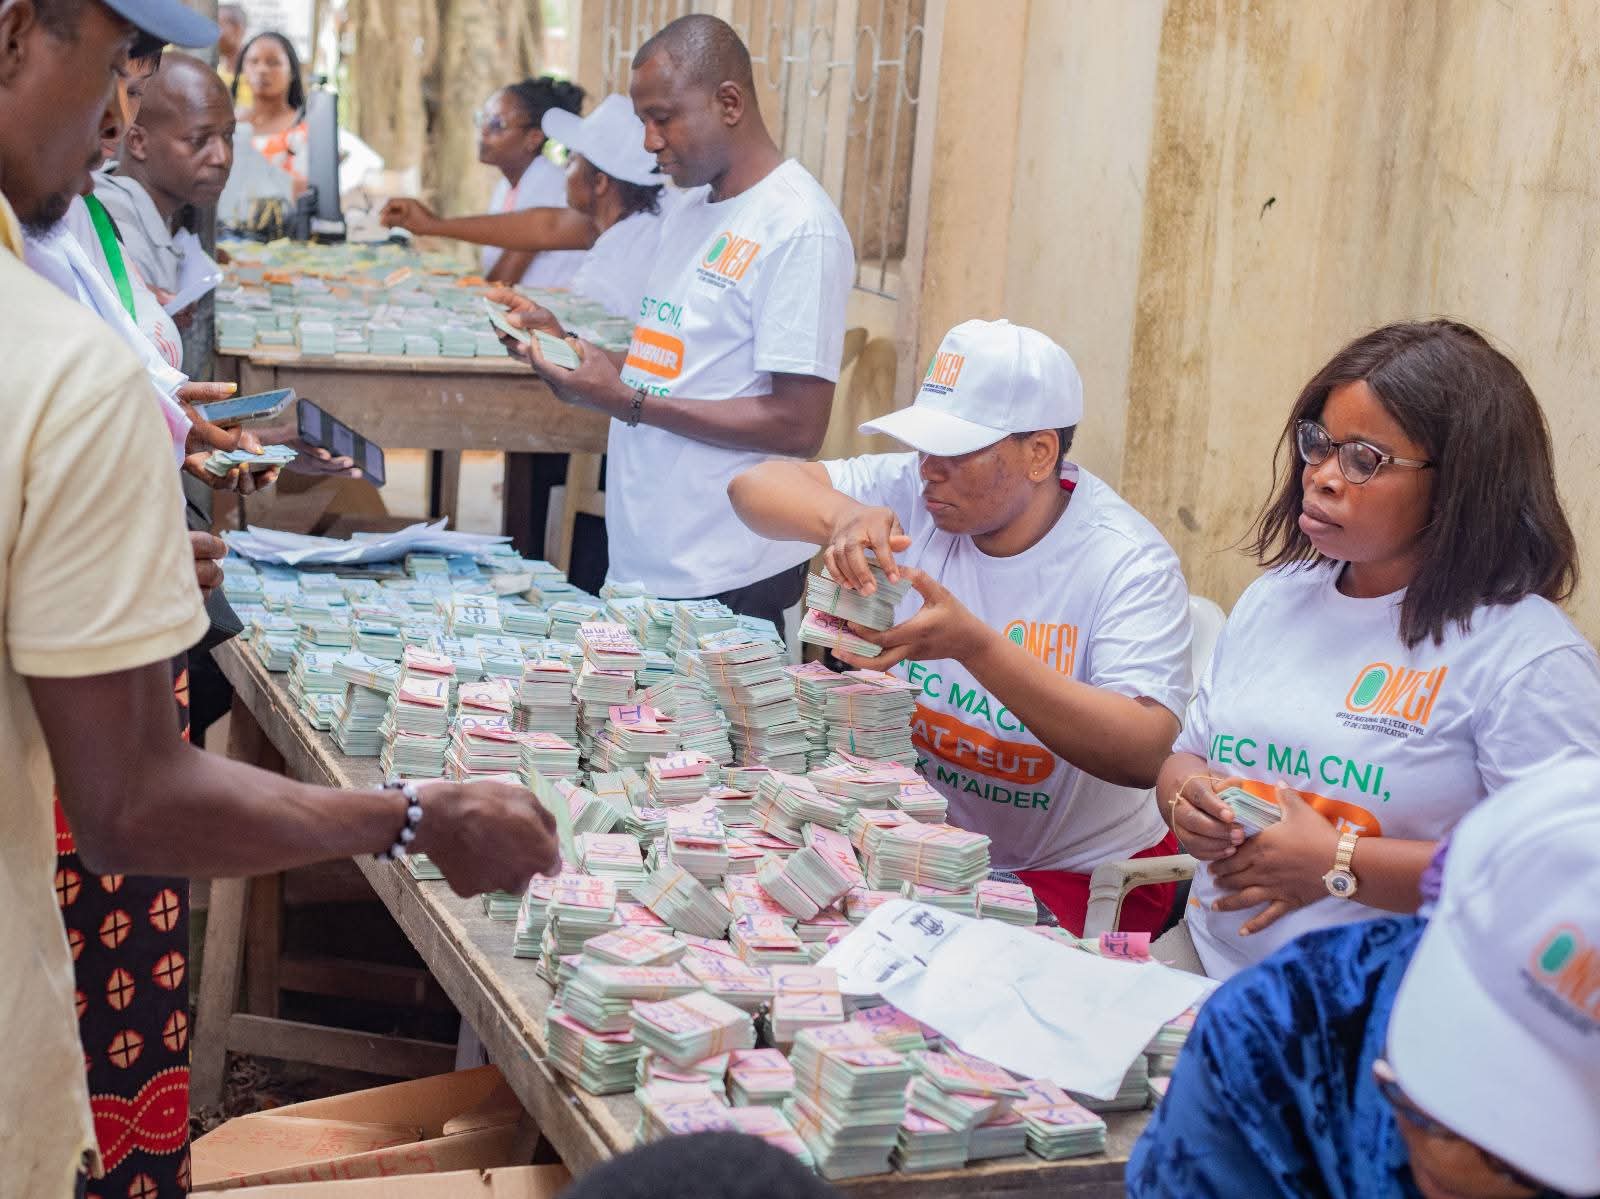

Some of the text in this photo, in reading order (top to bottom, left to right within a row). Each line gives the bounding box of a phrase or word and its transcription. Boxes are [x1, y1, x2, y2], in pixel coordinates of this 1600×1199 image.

[947, 682, 992, 721] MA
[955, 736, 1043, 777] PEUT
[1267, 743, 1311, 780] MA
[1319, 755, 1391, 803] CNI,
[936, 765, 1051, 811] M'AIDER
